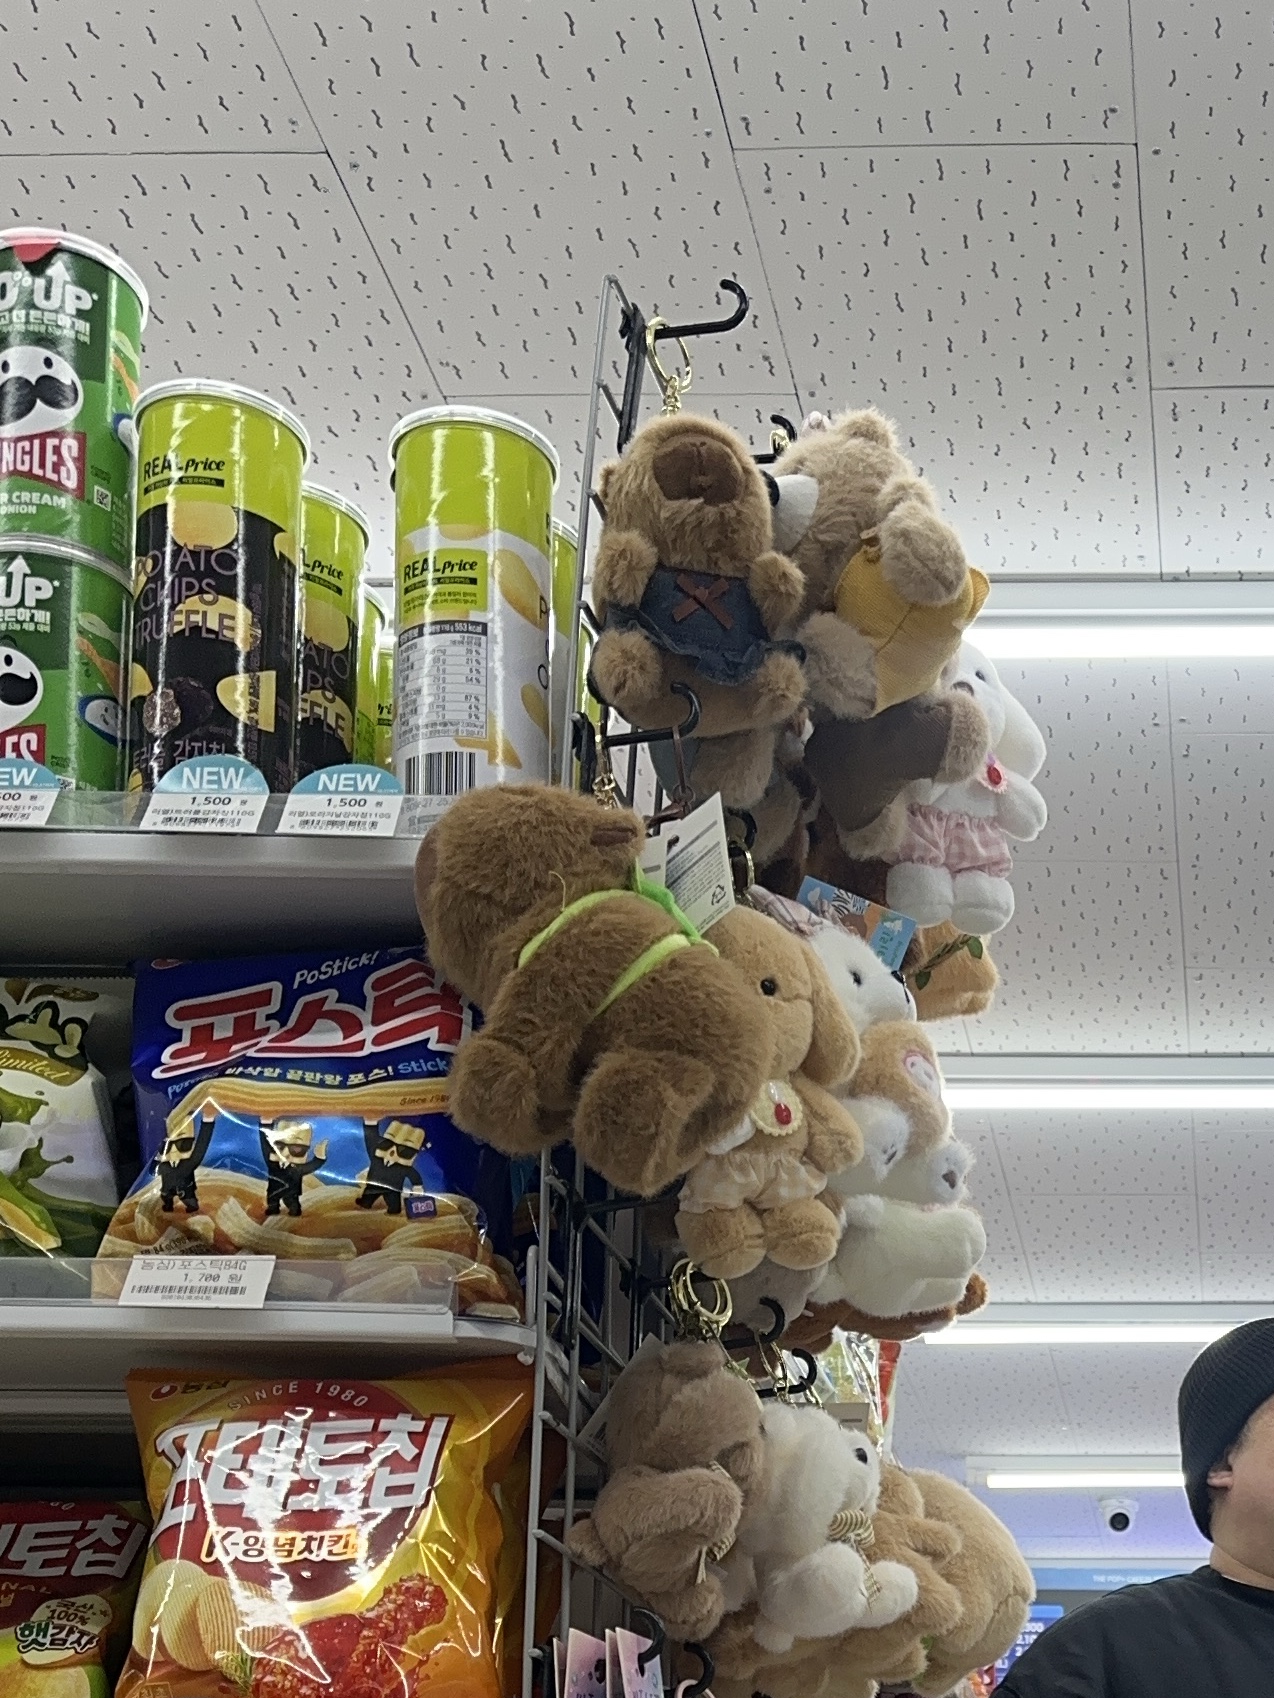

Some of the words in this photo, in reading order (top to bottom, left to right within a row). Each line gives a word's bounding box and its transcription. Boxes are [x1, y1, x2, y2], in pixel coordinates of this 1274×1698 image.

[0, 438, 79, 490] NGLES
[136, 543, 238, 582] POTATO
[140, 577, 218, 613] CHIPS
[135, 609, 236, 652] TRUFFLE
[300, 694, 346, 742] FFLE
[182, 767, 244, 791] NEW
[317, 773, 382, 792] NEW
[190, 797, 231, 807] 1,500
[326, 798, 367, 808] 1,500
[292, 950, 379, 991] PoStick!
[398, 1058, 448, 1074] Stick
[183, 1272, 222, 1284] 1,700
[228, 1271, 243, 1284] 원
[228, 1380, 300, 1412] SINCE
[313, 1381, 370, 1408] 1980
[0, 1512, 150, 1581] 토칩
[16, 1620, 100, 1653] 햇감자
